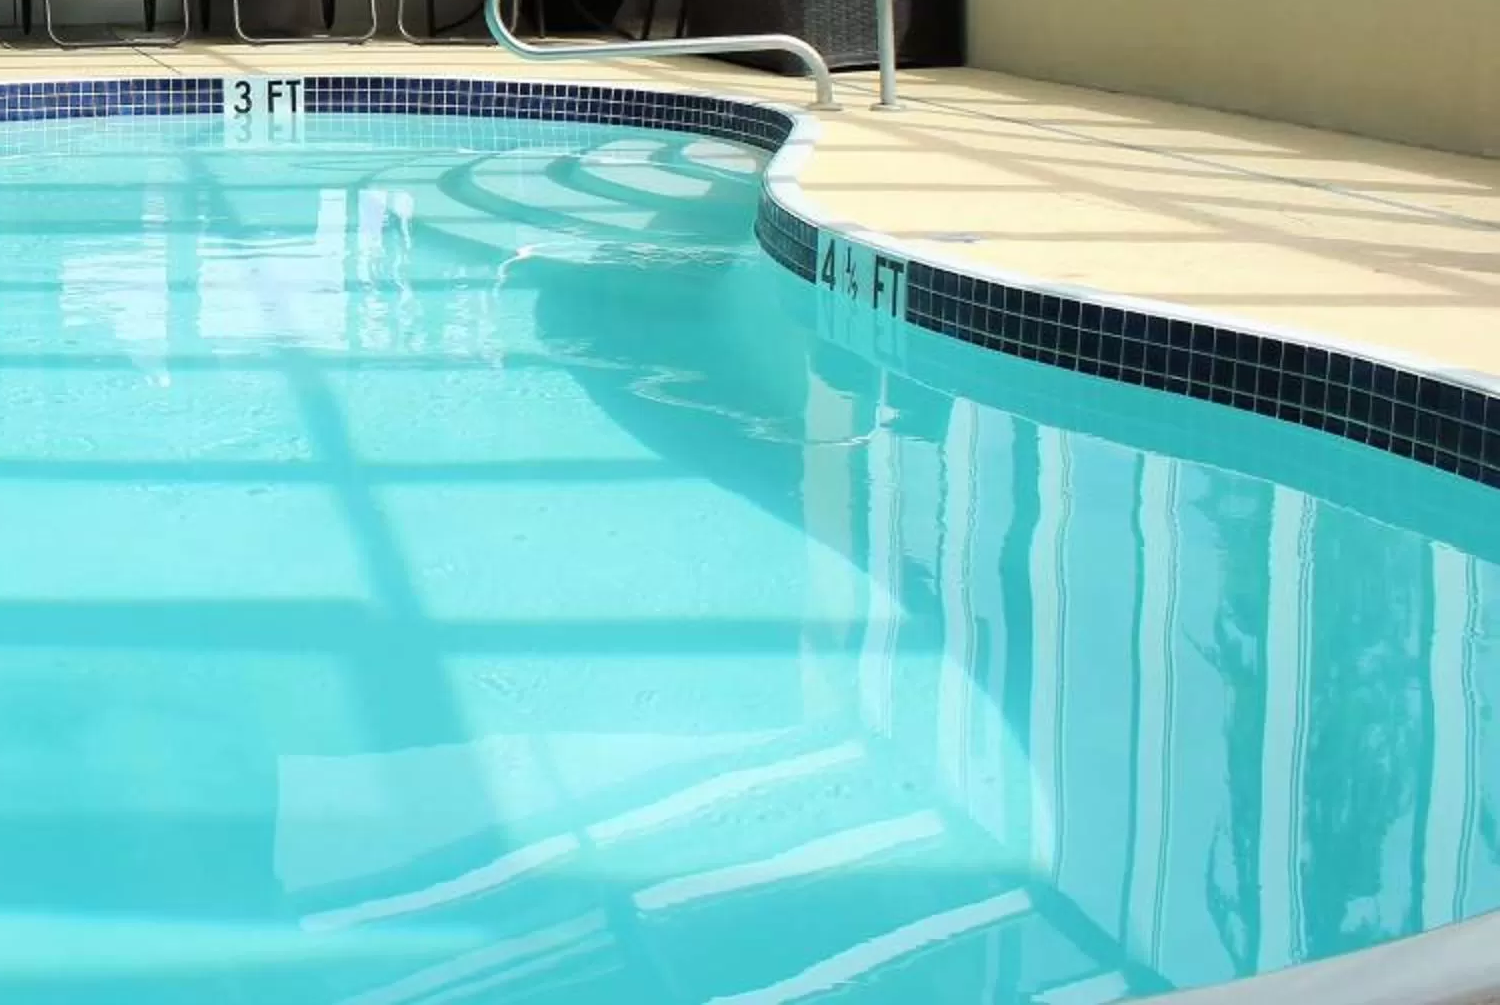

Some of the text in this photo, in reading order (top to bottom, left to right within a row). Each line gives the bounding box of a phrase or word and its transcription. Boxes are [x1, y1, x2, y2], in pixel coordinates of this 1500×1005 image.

[233, 79, 301, 113] 3 FT
[821, 239, 836, 291] 4
[873, 254, 905, 318] FT
